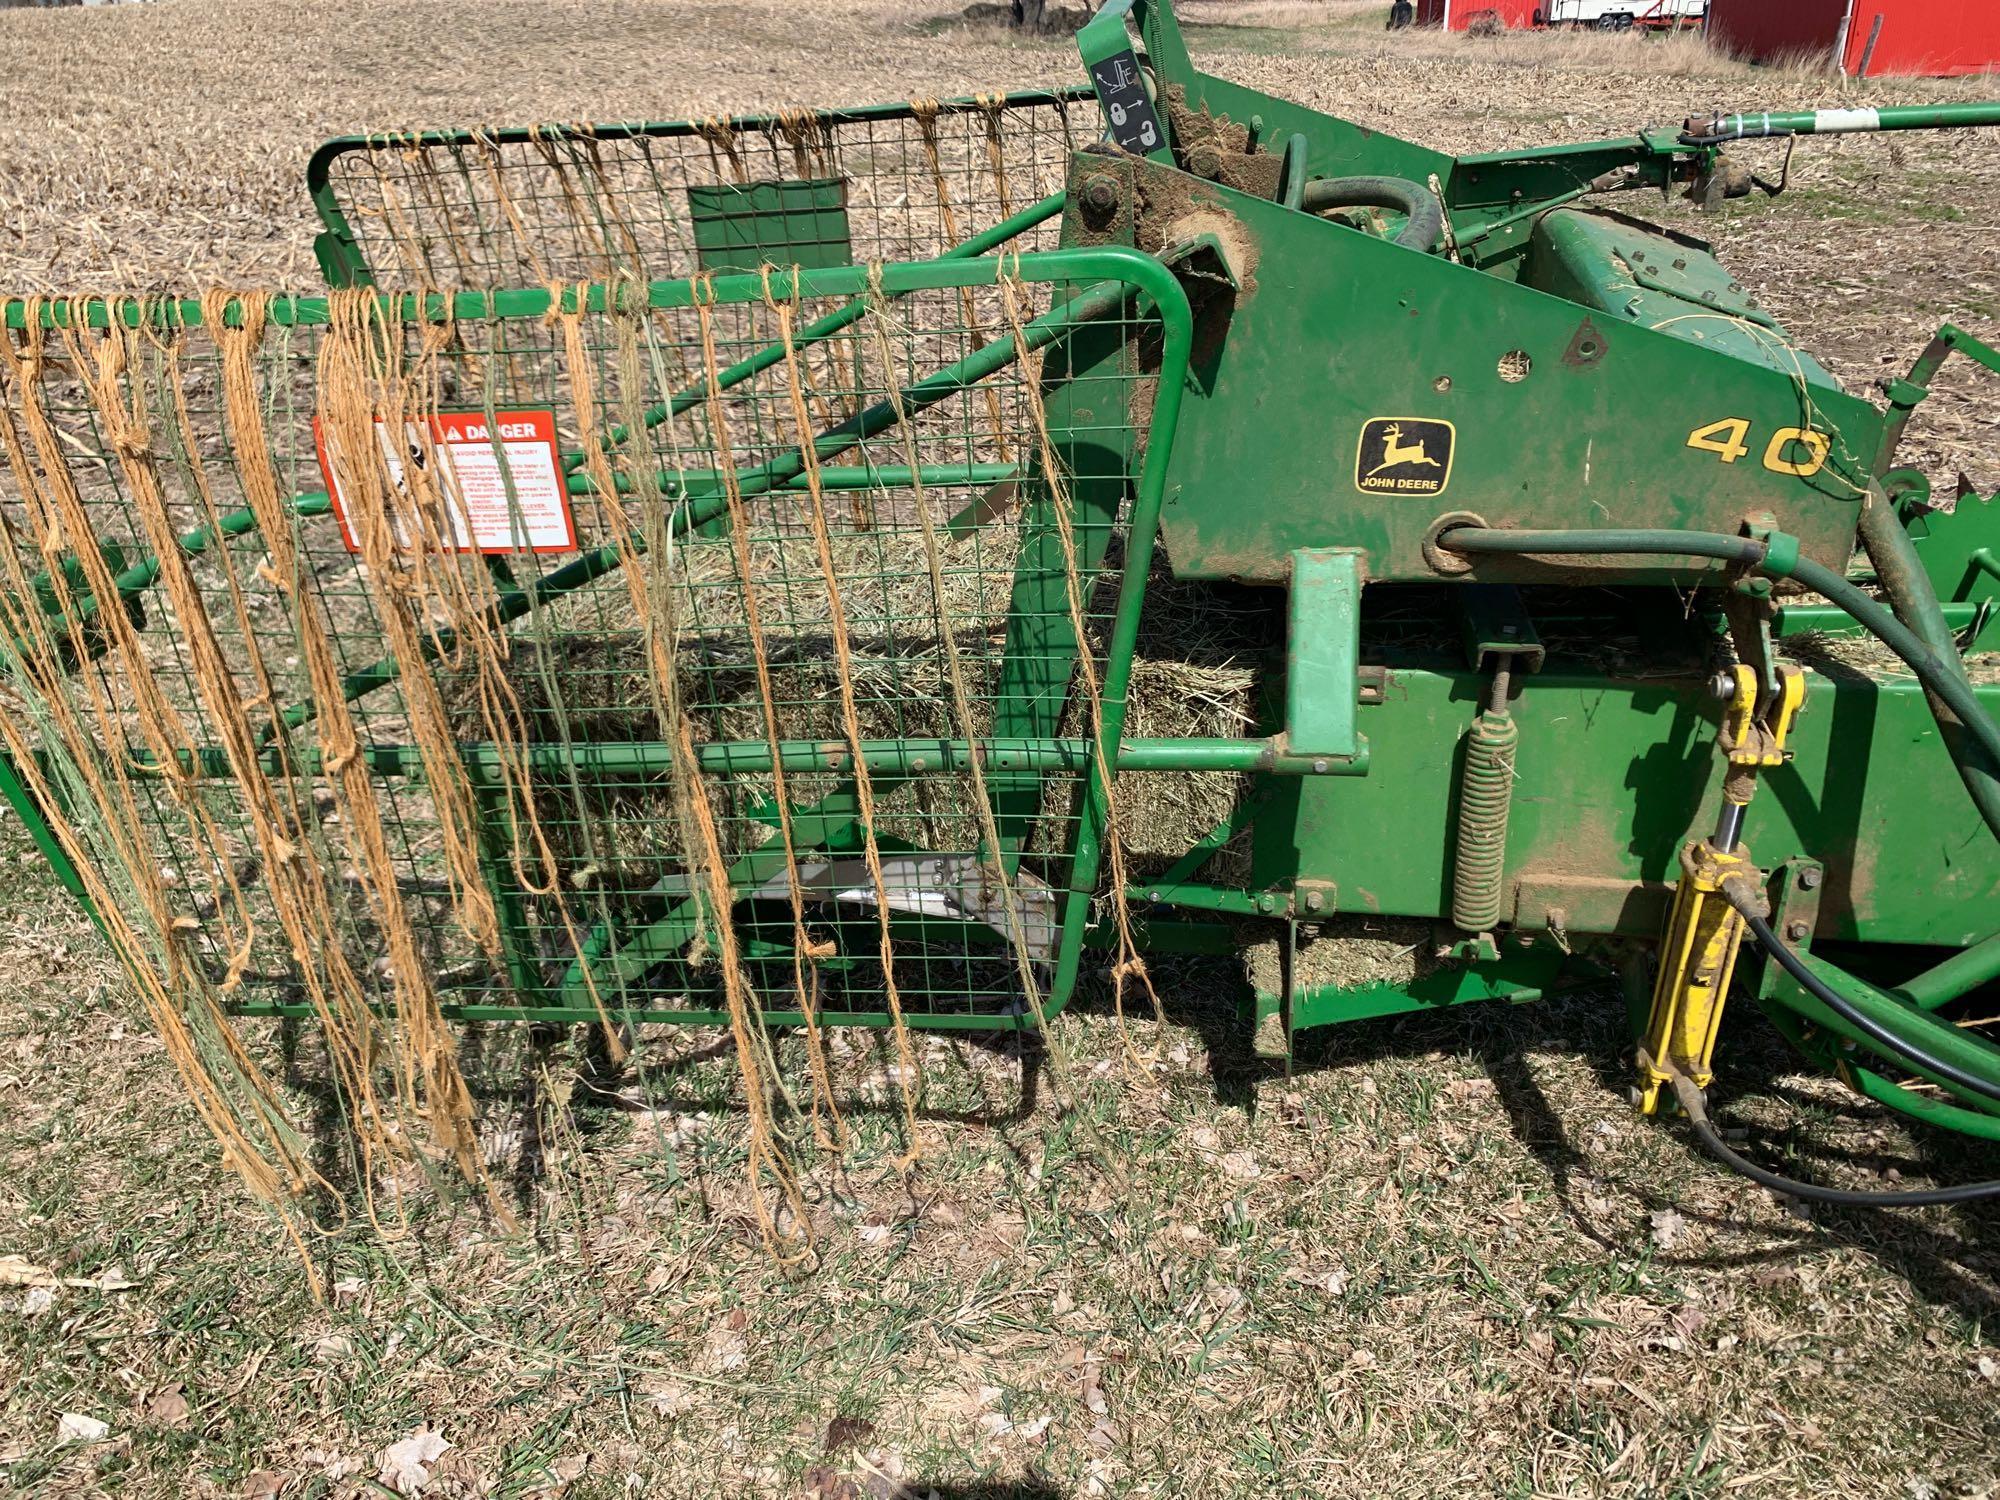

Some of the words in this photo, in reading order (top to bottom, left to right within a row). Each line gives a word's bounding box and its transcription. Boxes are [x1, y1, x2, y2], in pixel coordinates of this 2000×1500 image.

[465, 423, 537, 440] DAGER
[1361, 477, 1396, 488] JOHN
[1397, 478, 1439, 490] DEERE
